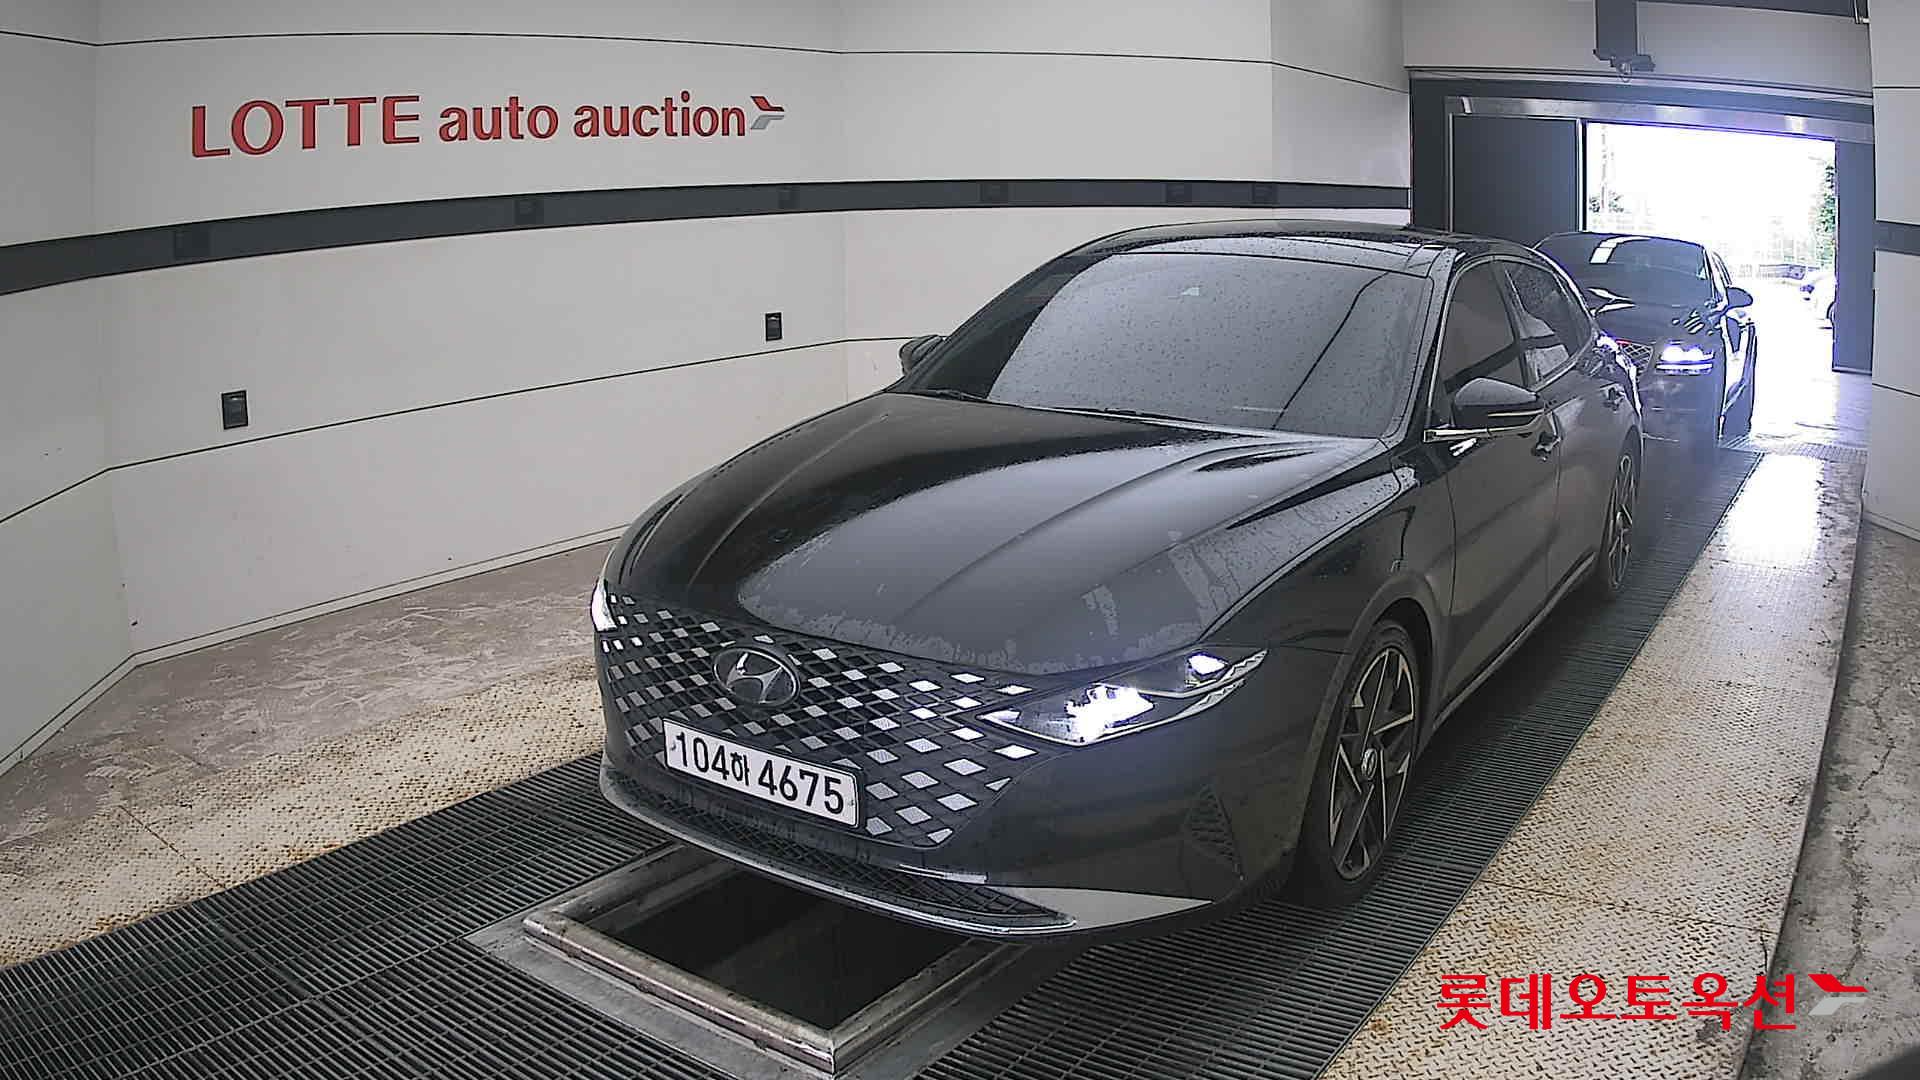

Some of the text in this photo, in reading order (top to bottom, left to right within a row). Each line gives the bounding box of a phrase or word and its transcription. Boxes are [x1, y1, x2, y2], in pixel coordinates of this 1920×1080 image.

[191, 90, 746, 158] LOTTE auto auction
[758, 759, 844, 814] 4675
